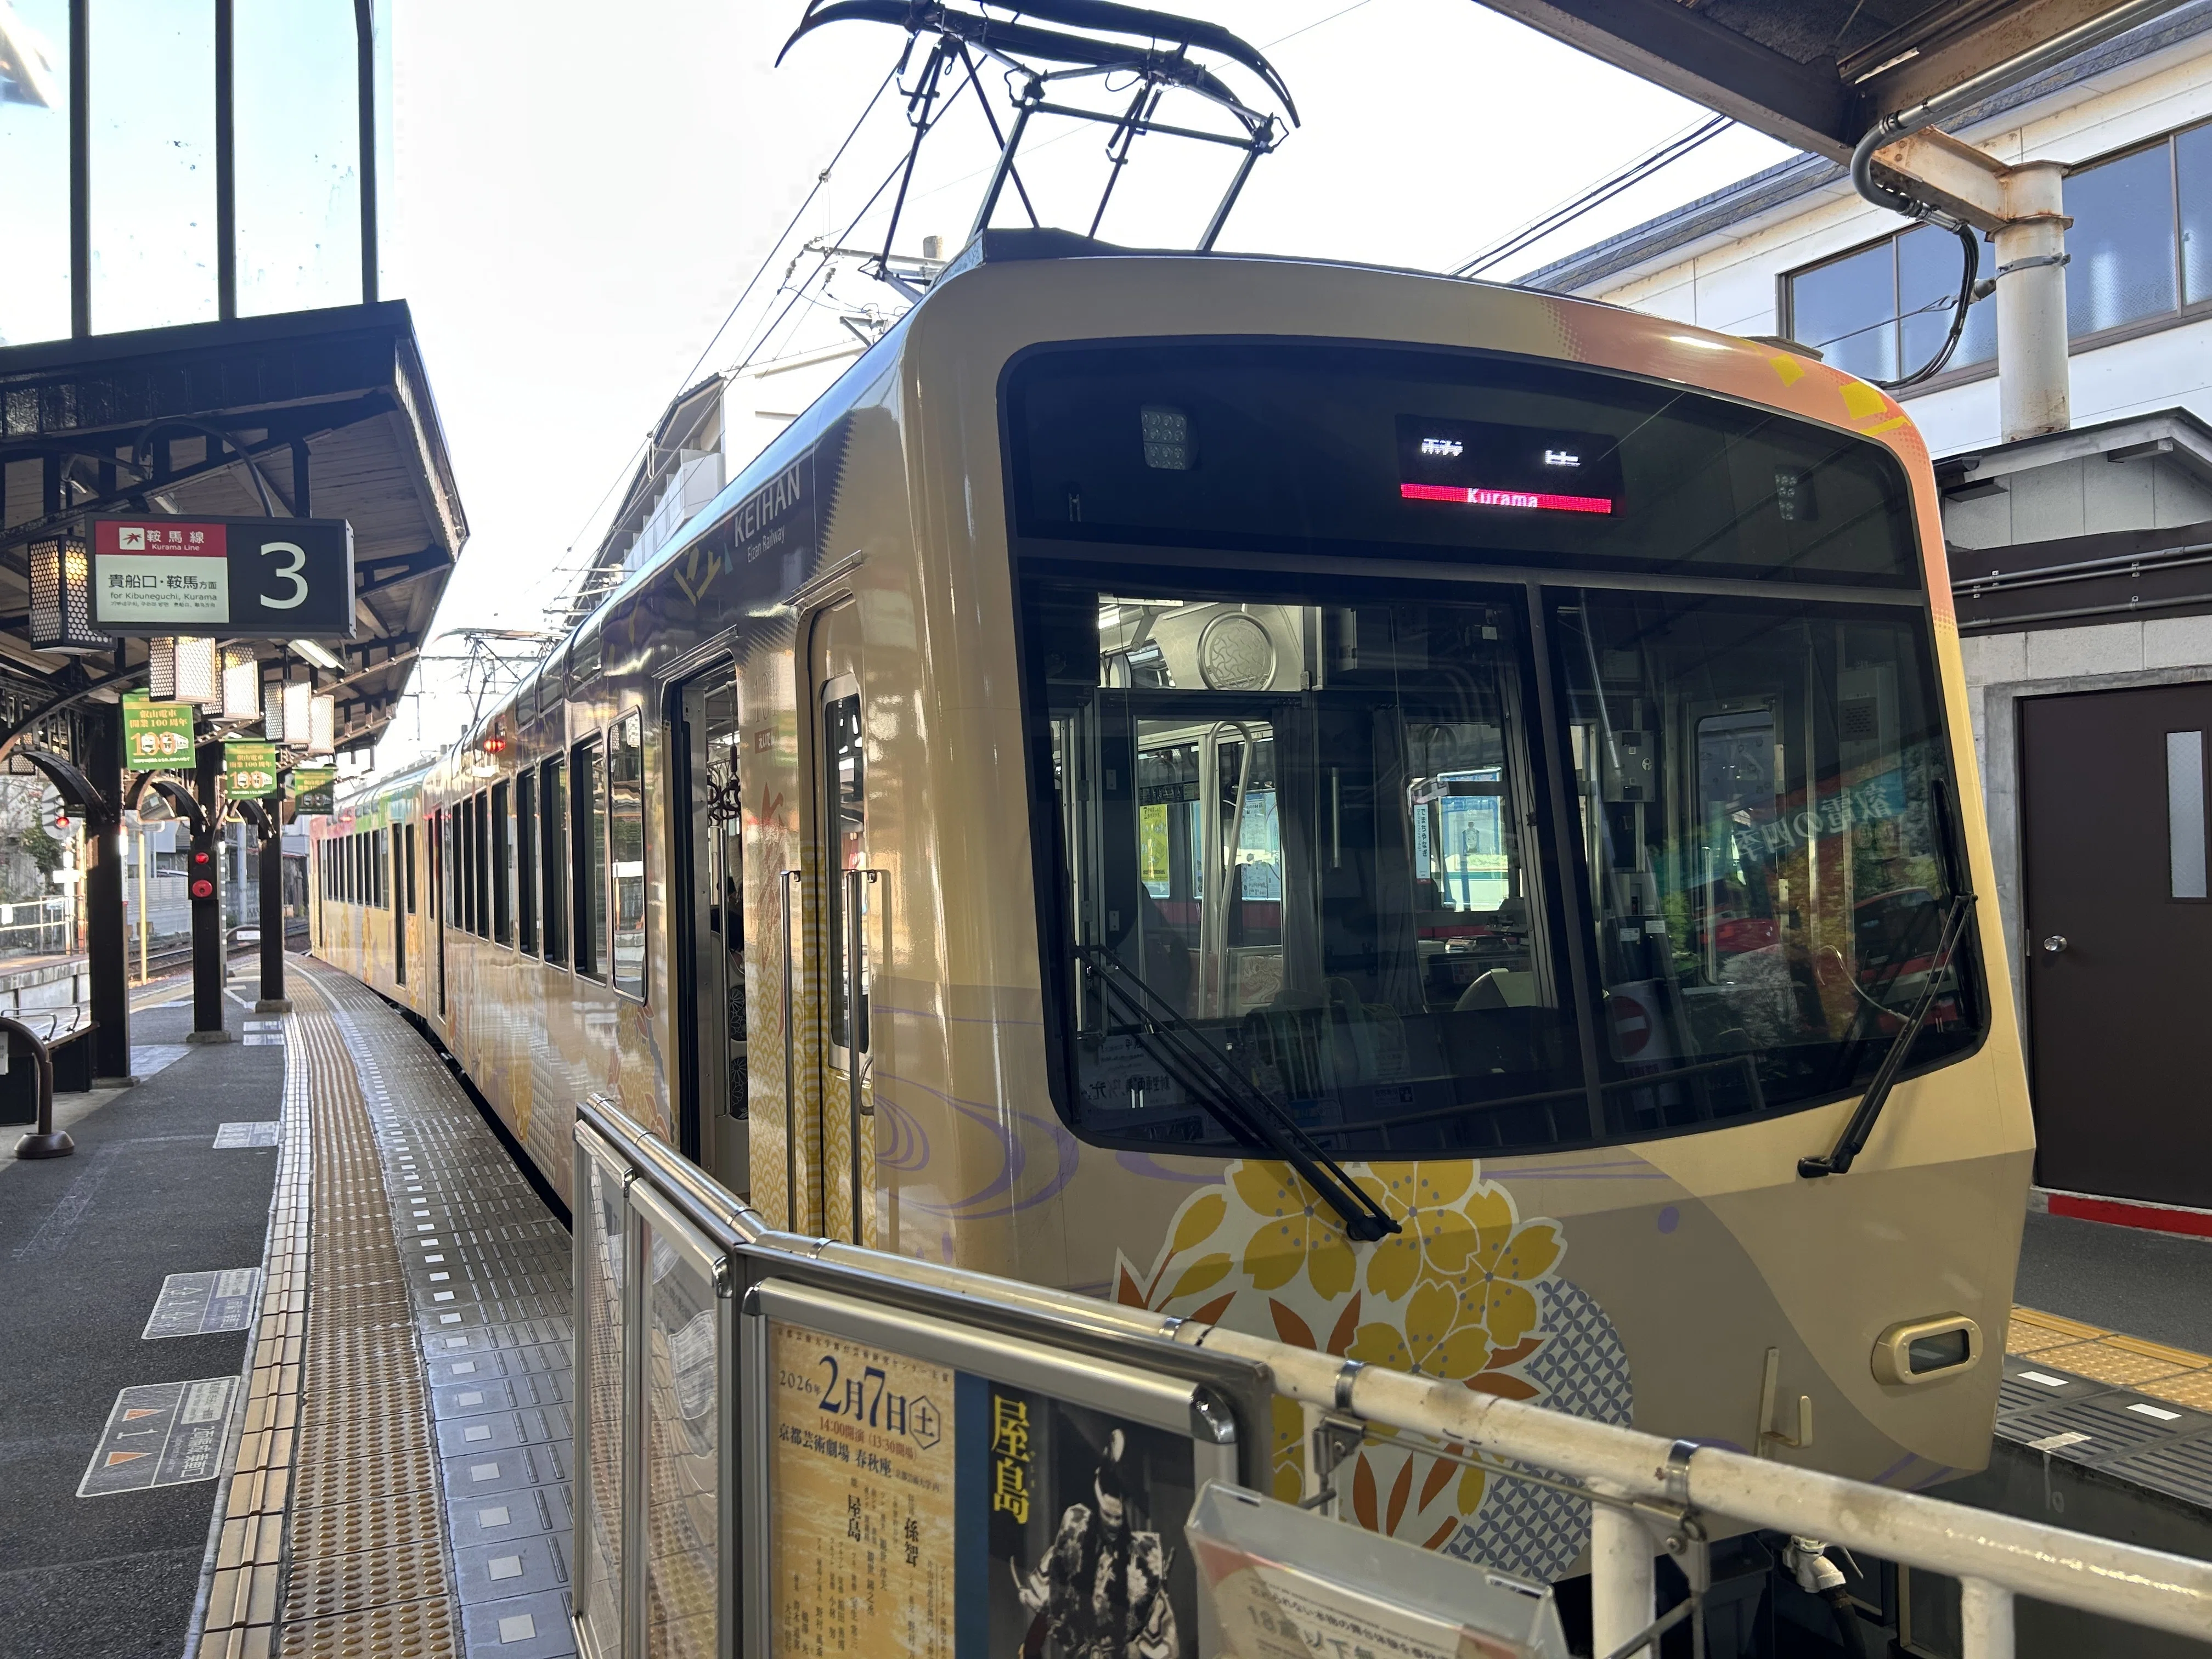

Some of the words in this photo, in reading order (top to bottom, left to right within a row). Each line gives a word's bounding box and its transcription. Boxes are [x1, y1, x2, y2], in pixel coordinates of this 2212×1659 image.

[734, 464, 800, 547] KEIHAN
[1468, 488, 1538, 507] Kurama
[146, 530, 204, 544] 鞍馬線
[747, 541, 762, 563] Eizan
[762, 525, 785, 554] Railway
[108, 574, 217, 590] 貴船口・鞍馬方面
[259, 541, 309, 610] 3
[126, 592, 182, 601] Kibuneguchi,
[819, 1356, 906, 1436] 2月7日
[991, 1394, 1030, 1525] 屋島
